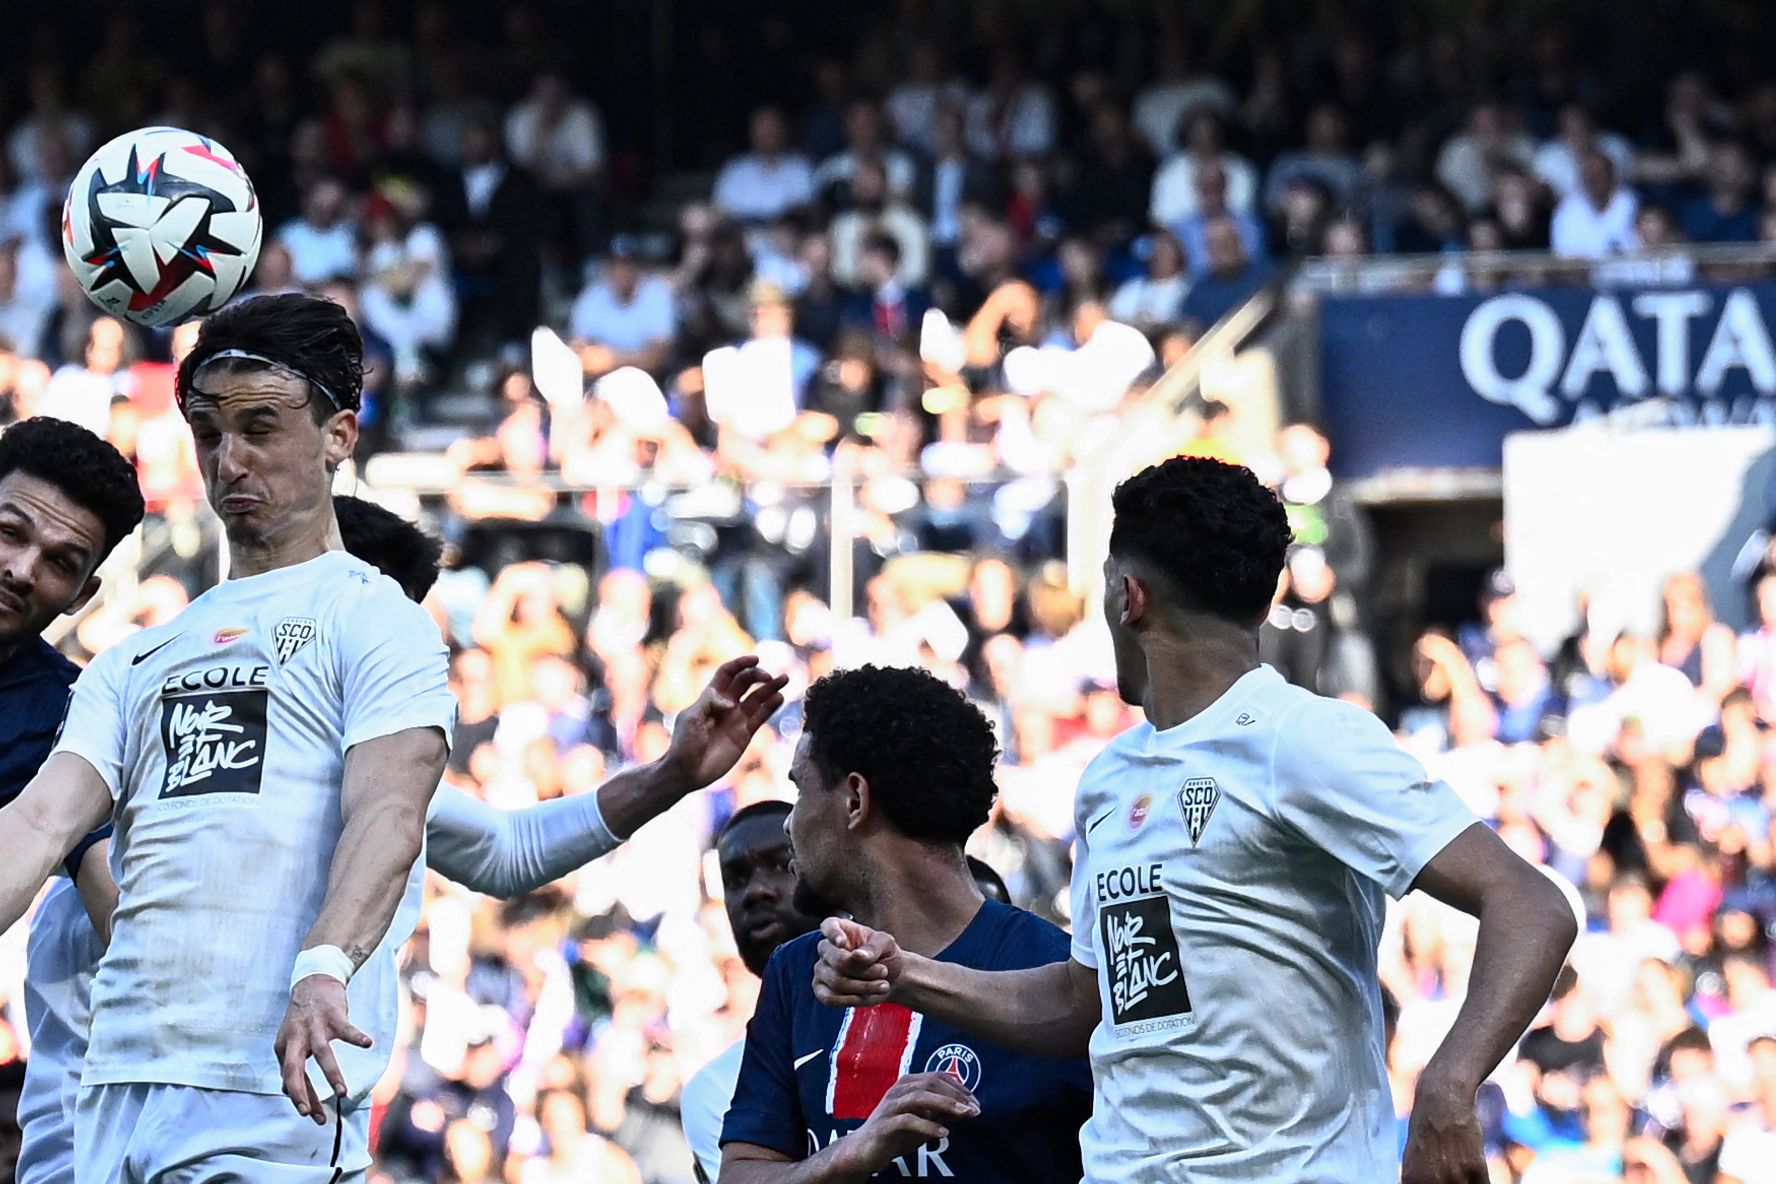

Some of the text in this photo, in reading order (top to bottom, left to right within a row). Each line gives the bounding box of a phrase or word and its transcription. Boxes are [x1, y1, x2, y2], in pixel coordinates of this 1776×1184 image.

[279, 624, 311, 639] SCO
[162, 667, 269, 694] ECOLE
[165, 740, 259, 792] BLANC
[1185, 787, 1213, 806] SCO
[1097, 864, 1162, 901] ECOLE
[1113, 952, 1178, 1016] BLANC
[937, 1047, 974, 1063] PARIS
